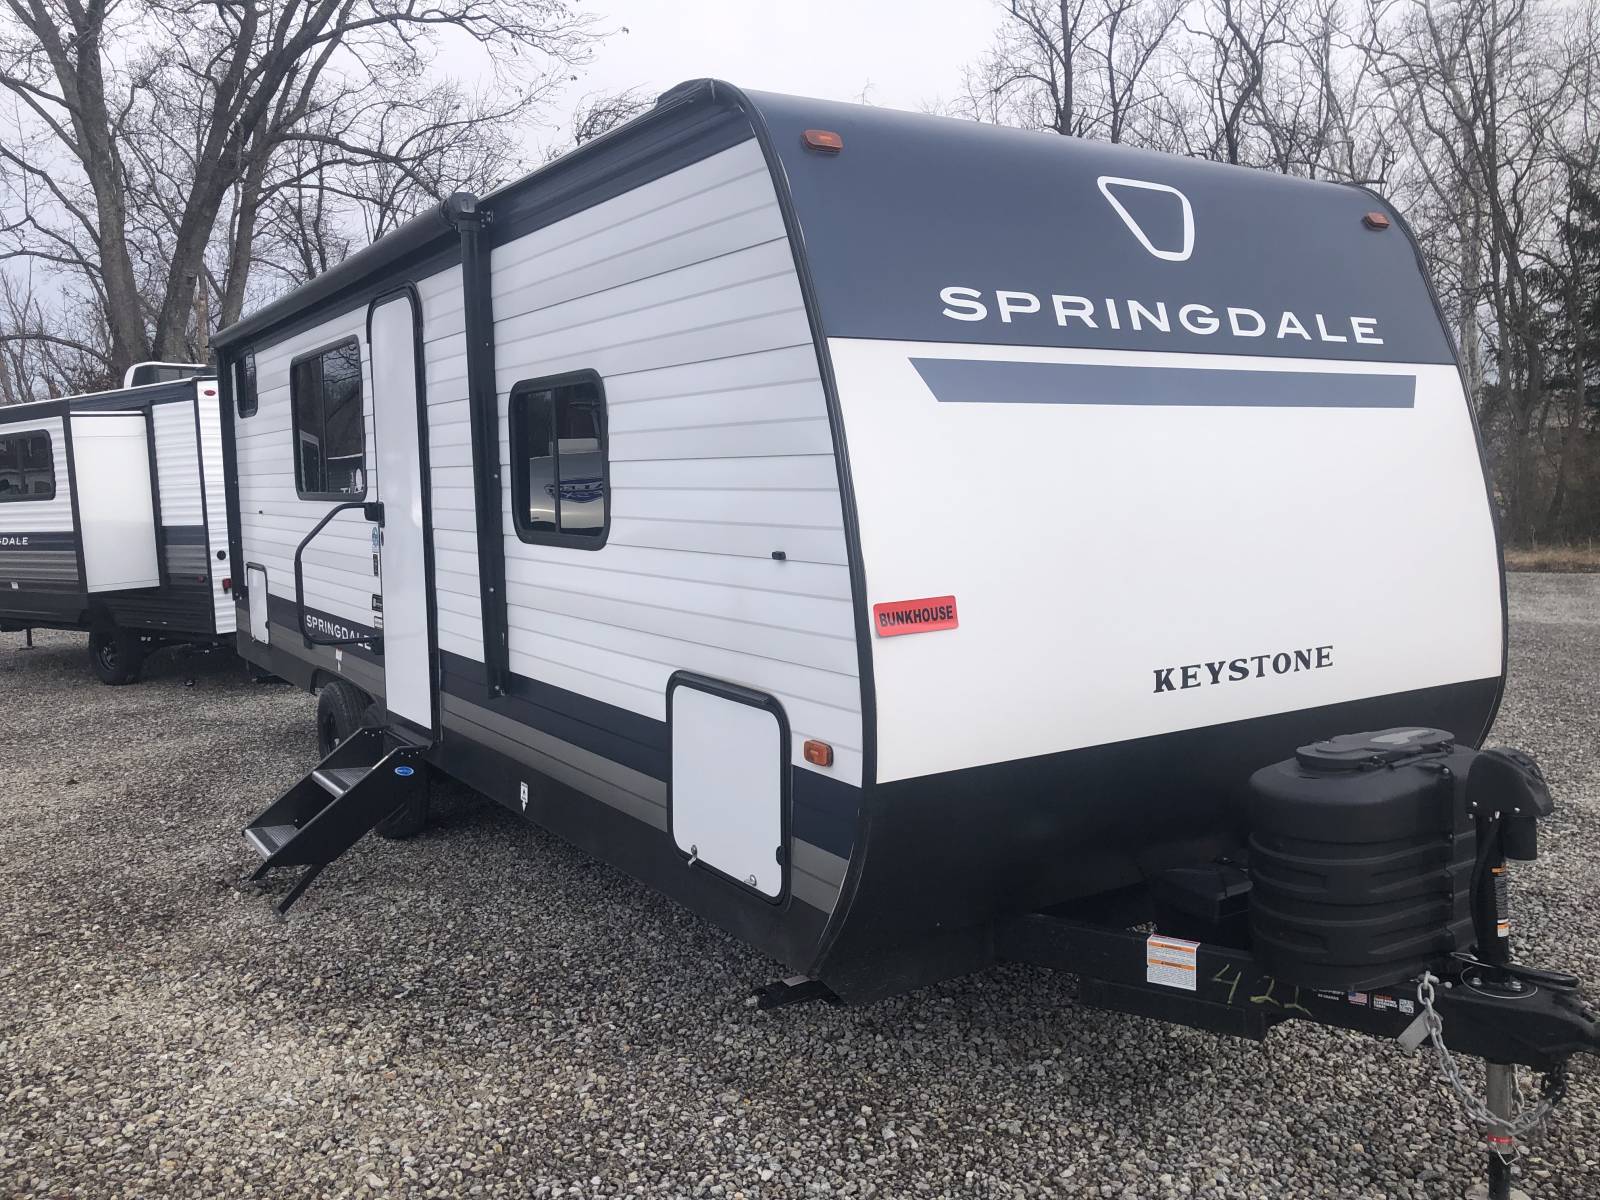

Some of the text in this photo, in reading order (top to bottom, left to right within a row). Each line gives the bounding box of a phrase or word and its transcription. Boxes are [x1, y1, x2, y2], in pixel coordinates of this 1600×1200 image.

[939, 286, 1385, 345] SPRINGDALE
[0, 536, 29, 546] DALE
[879, 604, 954, 628] BUNKHOUSE
[1152, 645, 1334, 694] KEYSTONE
